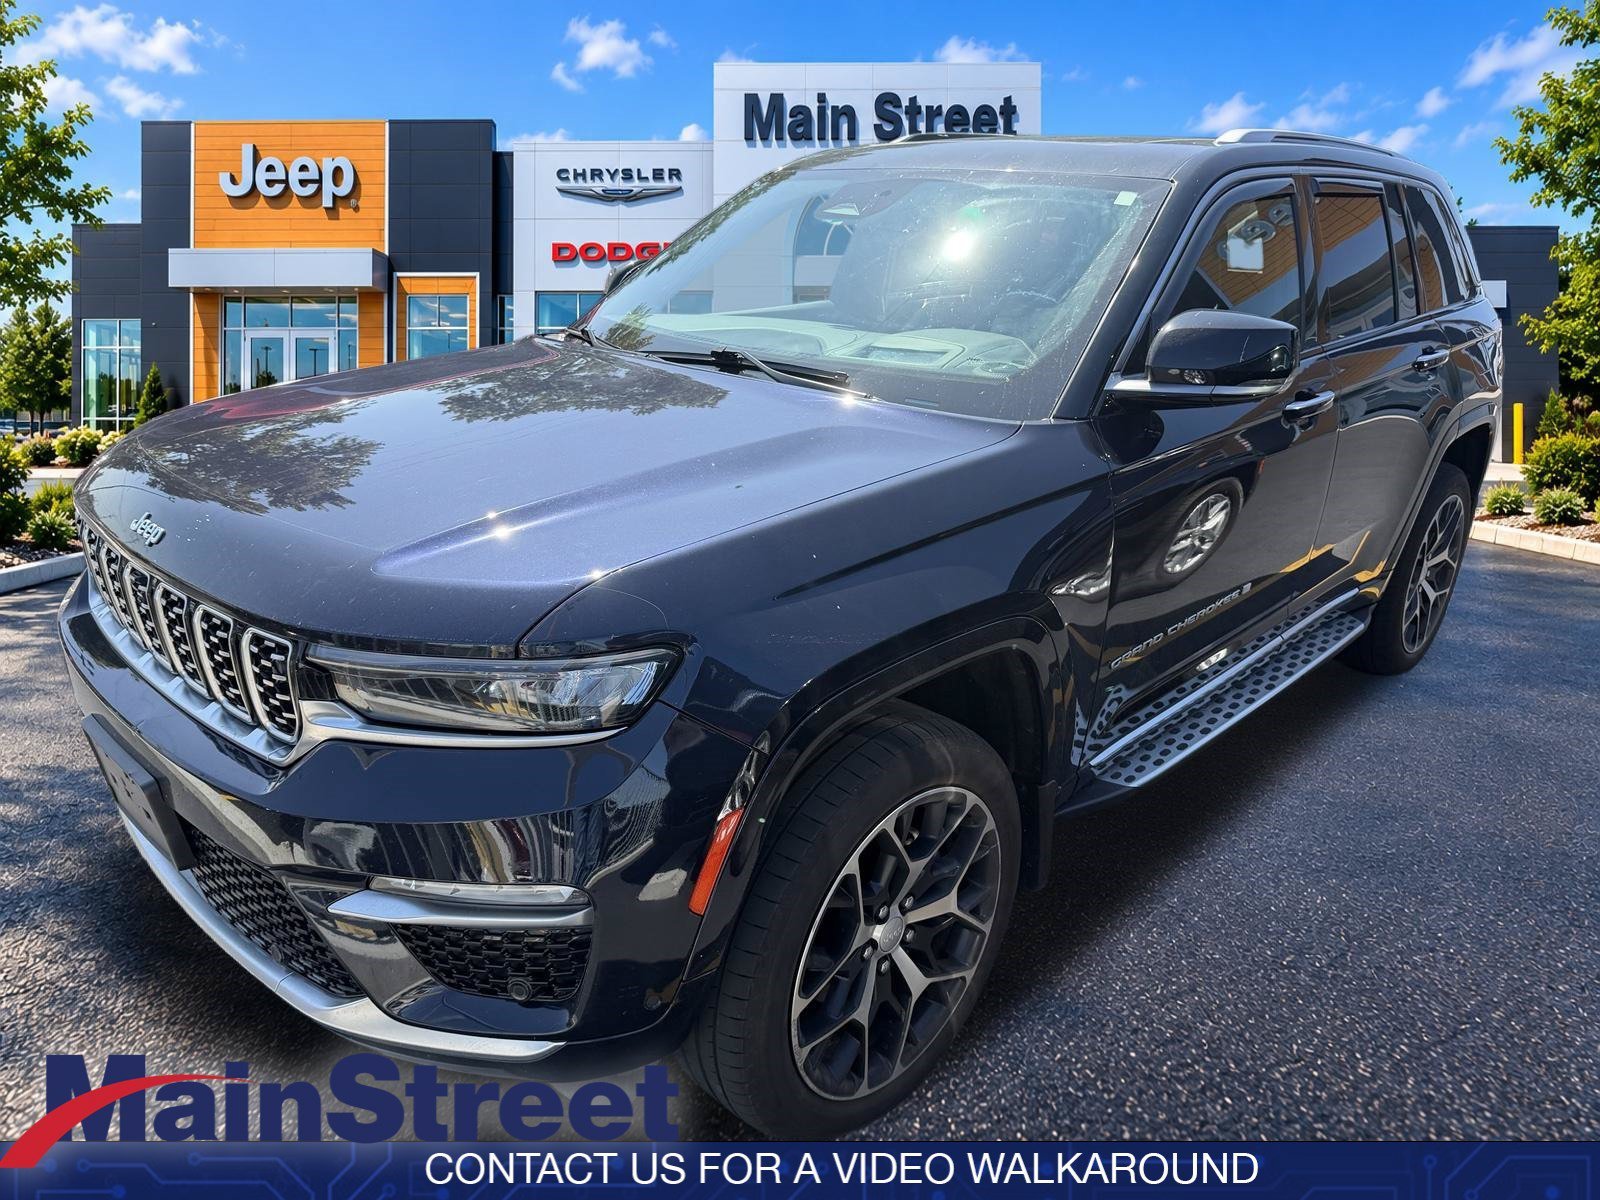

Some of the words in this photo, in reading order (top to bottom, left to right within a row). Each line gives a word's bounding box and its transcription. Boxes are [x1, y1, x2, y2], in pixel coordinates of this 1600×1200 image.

[743, 92, 858, 141] Main
[873, 91, 1017, 141] Street
[219, 143, 355, 209] Jeep
[556, 168, 683, 182] CHRYSLER
[551, 242, 673, 261] DODG
[130, 511, 166, 546] Jeep
[1110, 632, 1164, 670] GRAND
[1167, 589, 1241, 636] CHEROKEE
